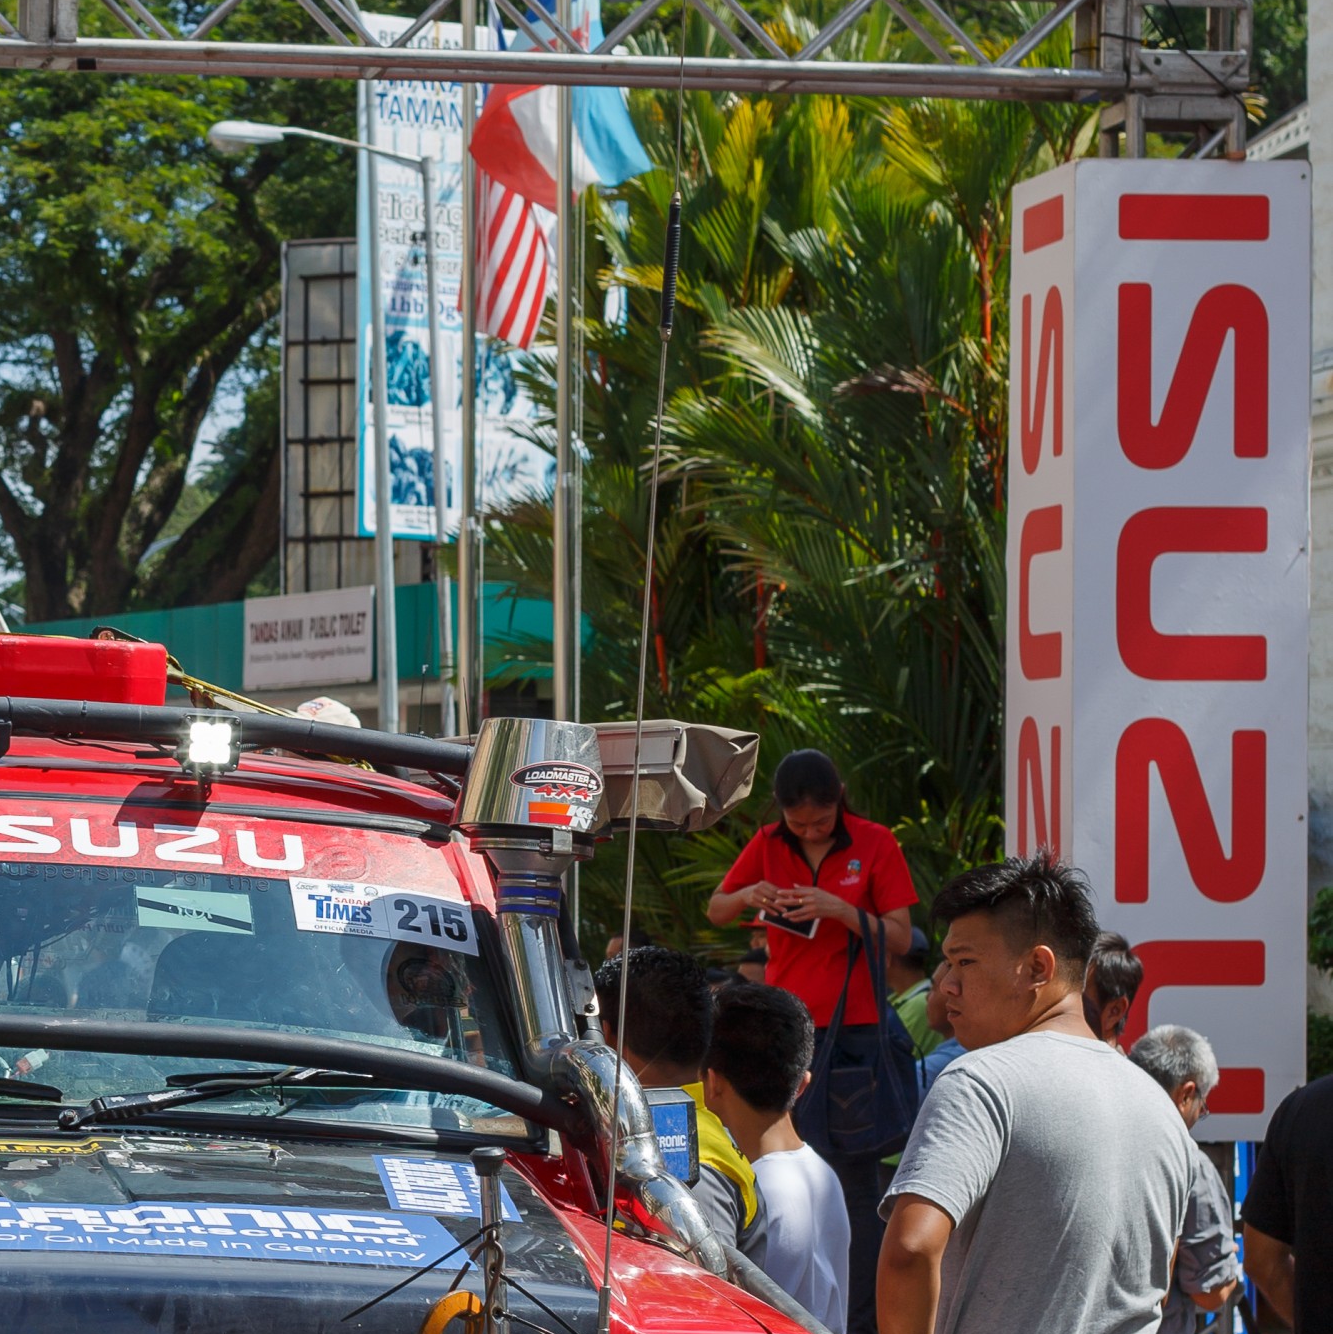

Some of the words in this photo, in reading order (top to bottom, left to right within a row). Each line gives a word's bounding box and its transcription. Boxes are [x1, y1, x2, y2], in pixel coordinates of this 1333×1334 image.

[1017, 194, 1065, 863] ISUZ
[1114, 193, 1271, 1116] ISUZU
[525, 770, 590, 784] LOADMASTER
[307, 894, 373, 924] TIMES
[334, 896, 371, 907] SABAH
[313, 923, 349, 934] OFFICIAL
[348, 926, 374, 936] MEDIA
[393, 898, 468, 943] 215
[657, 1134, 687, 1148] RONIC
[44, 1233, 93, 1245] Oil
[106, 1236, 209, 1249] Made
[220, 1239, 250, 1251] in
[264, 1242, 428, 1262] Germany
[82, 1223, 421, 1247] Deutschland
